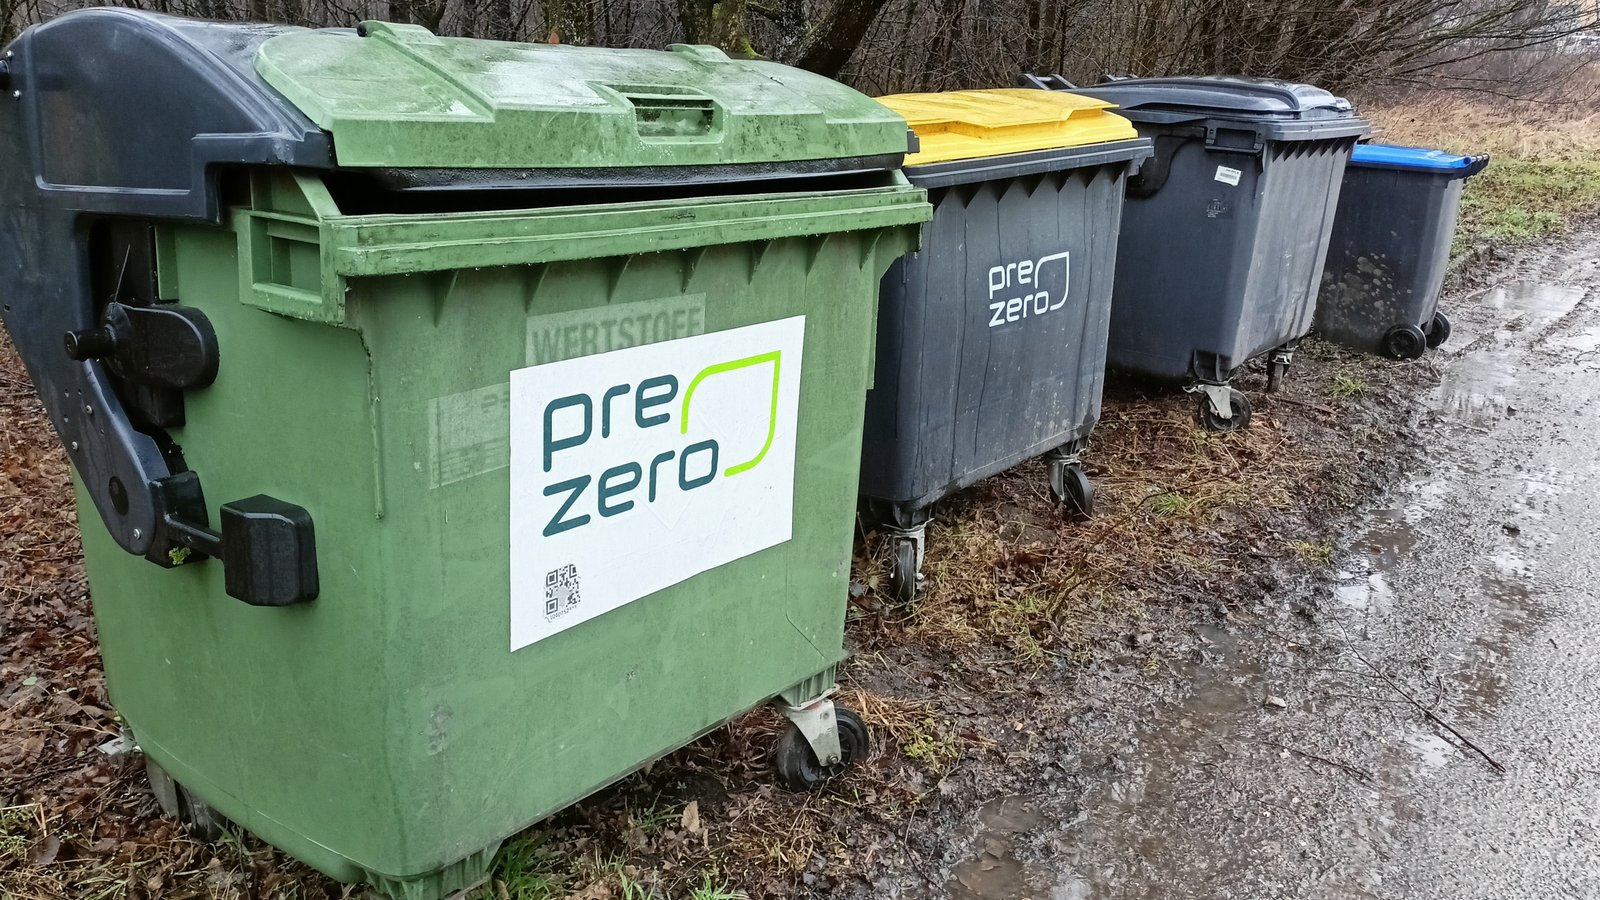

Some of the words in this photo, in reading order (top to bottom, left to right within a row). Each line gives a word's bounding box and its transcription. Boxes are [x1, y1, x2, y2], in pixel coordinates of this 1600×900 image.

[988, 259, 1034, 300] pre
[988, 290, 1050, 328] zero
[542, 374, 679, 473] pre
[542, 438, 720, 538] zero
